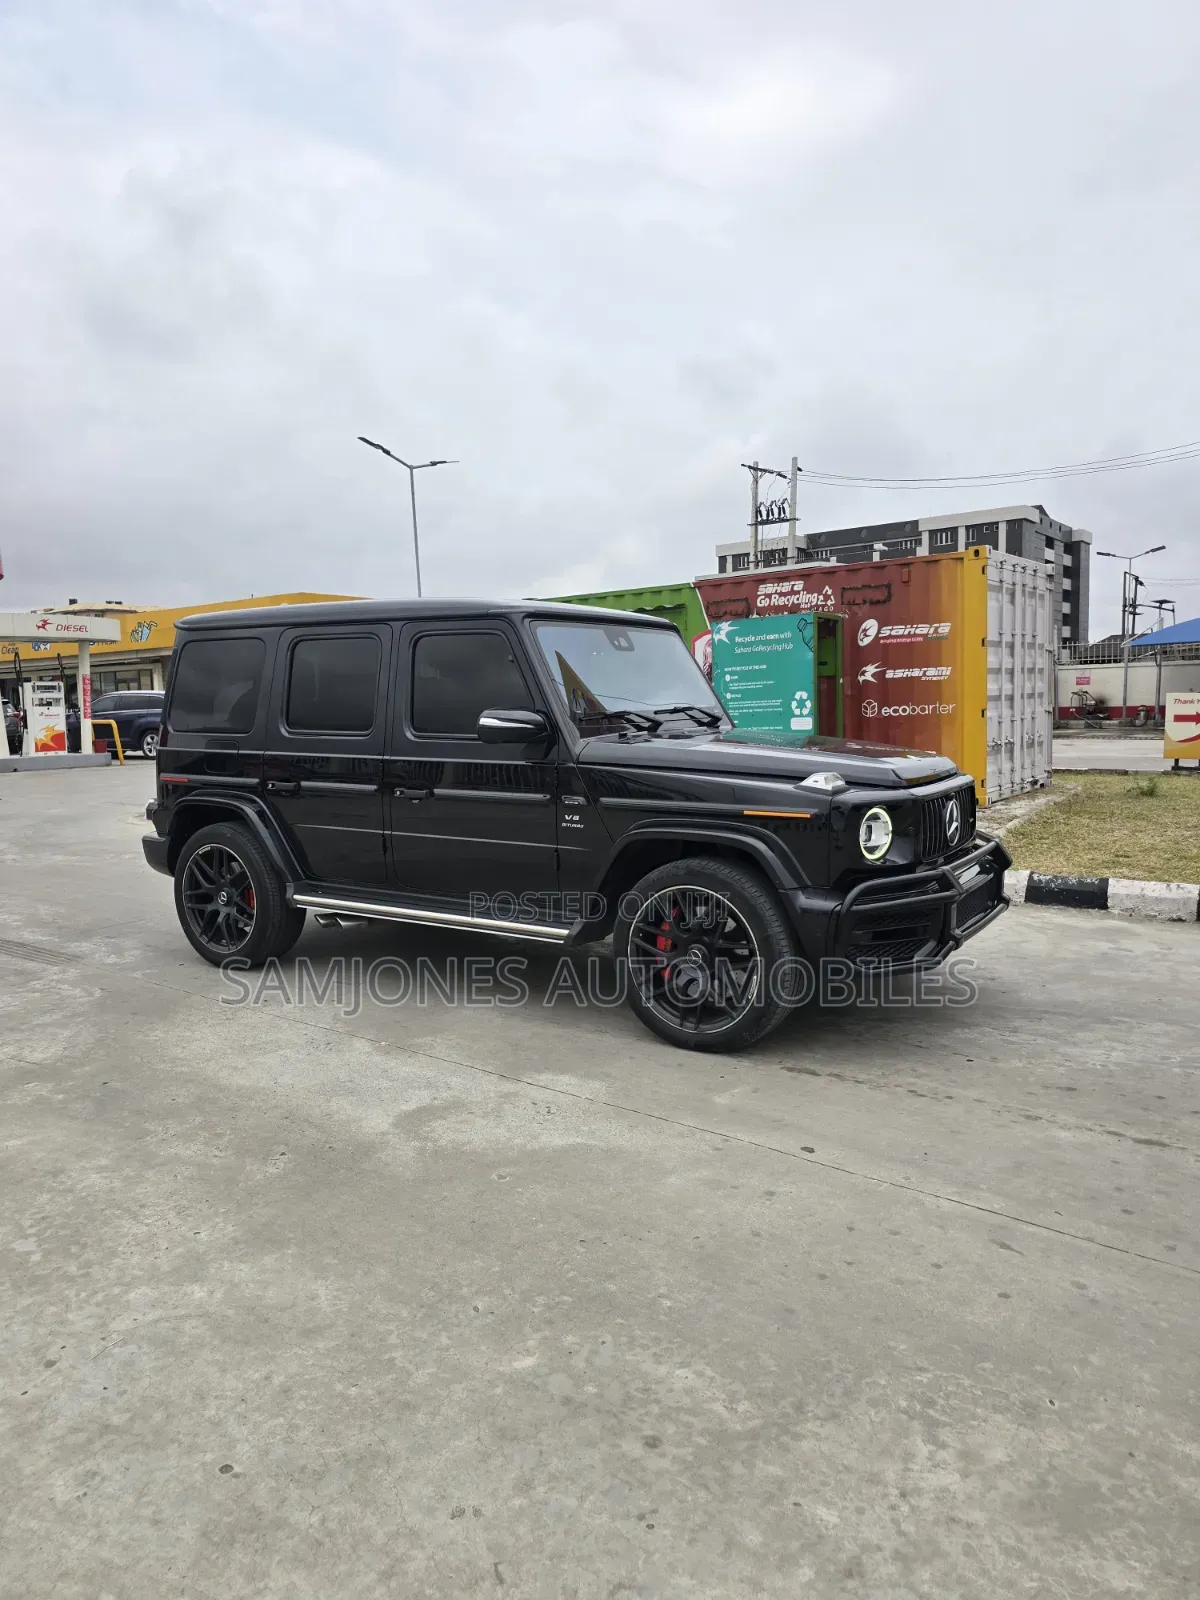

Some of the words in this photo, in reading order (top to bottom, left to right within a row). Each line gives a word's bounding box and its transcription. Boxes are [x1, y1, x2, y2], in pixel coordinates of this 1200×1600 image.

[757, 595, 769, 607] Go
[770, 590, 818, 607] Recycling
[56, 624, 88, 633] DIESEL
[735, 634, 755, 643] Recycle
[780, 631, 792, 639] with
[881, 701, 956, 717] ecobarter
